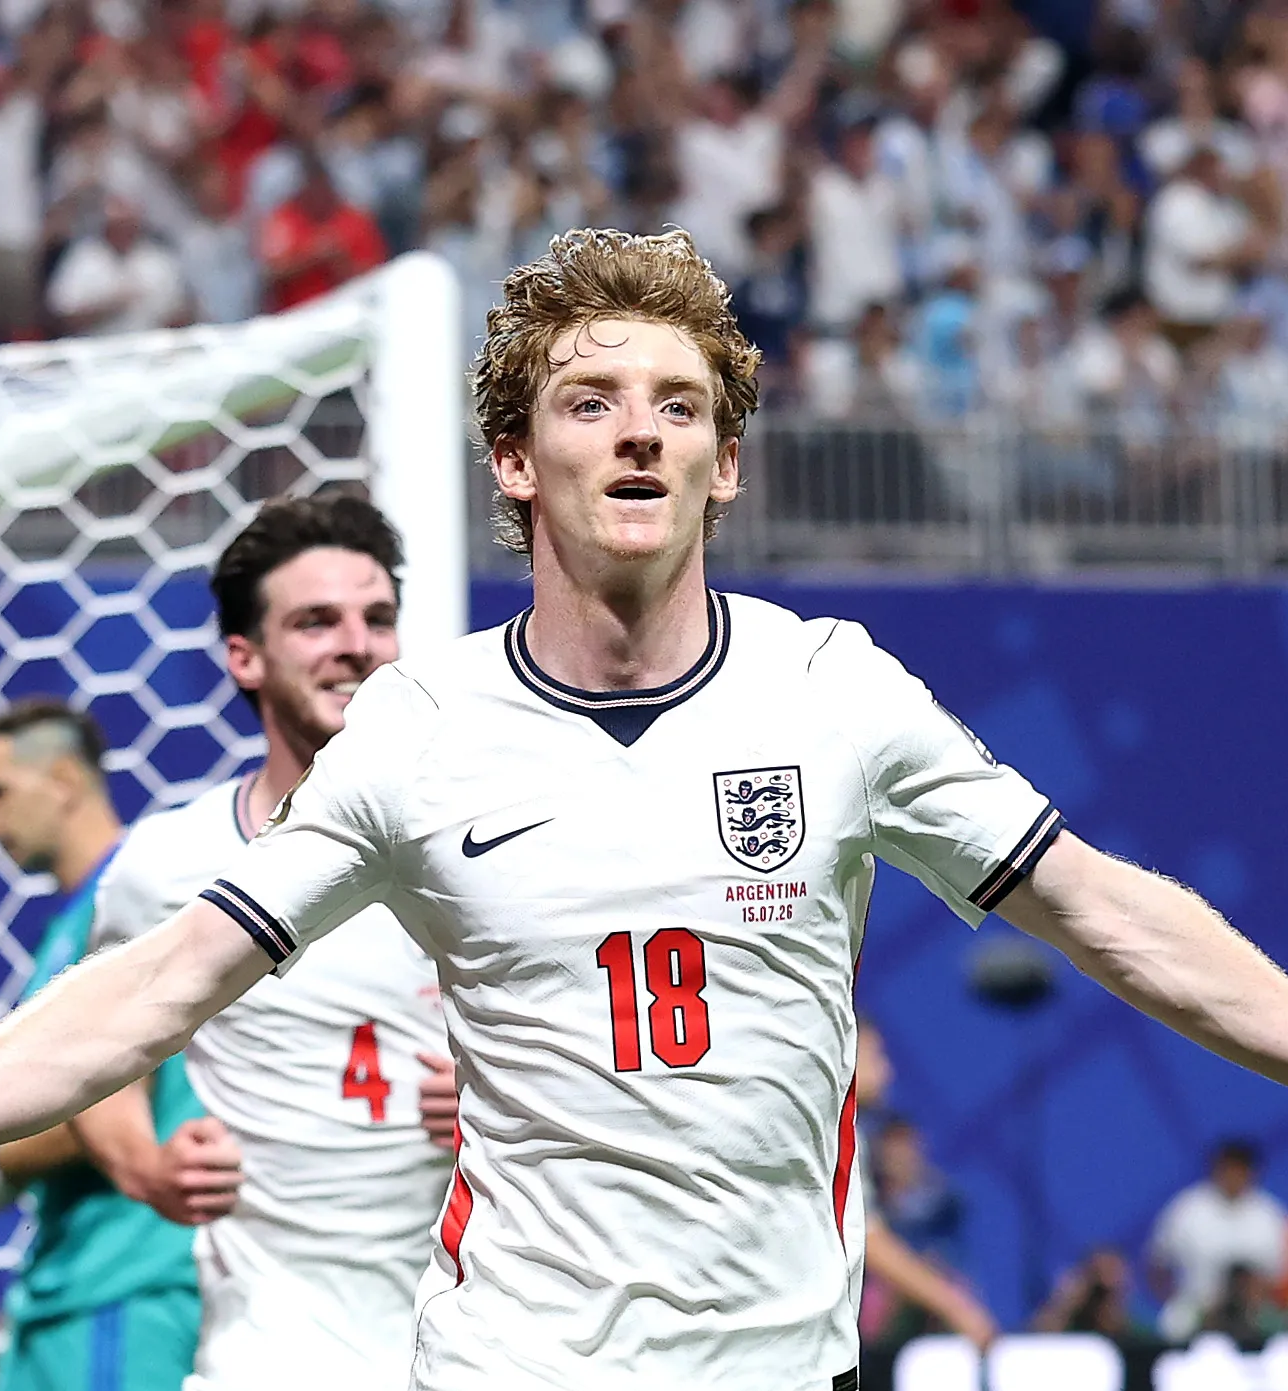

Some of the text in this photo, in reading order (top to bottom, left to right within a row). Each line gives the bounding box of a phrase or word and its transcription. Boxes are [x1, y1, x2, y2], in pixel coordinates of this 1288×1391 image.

[725, 881, 808, 902] ARGENTINA
[742, 904, 793, 923] 15.07.26
[596, 927, 711, 1072] 18
[341, 1020, 391, 1124] 4
